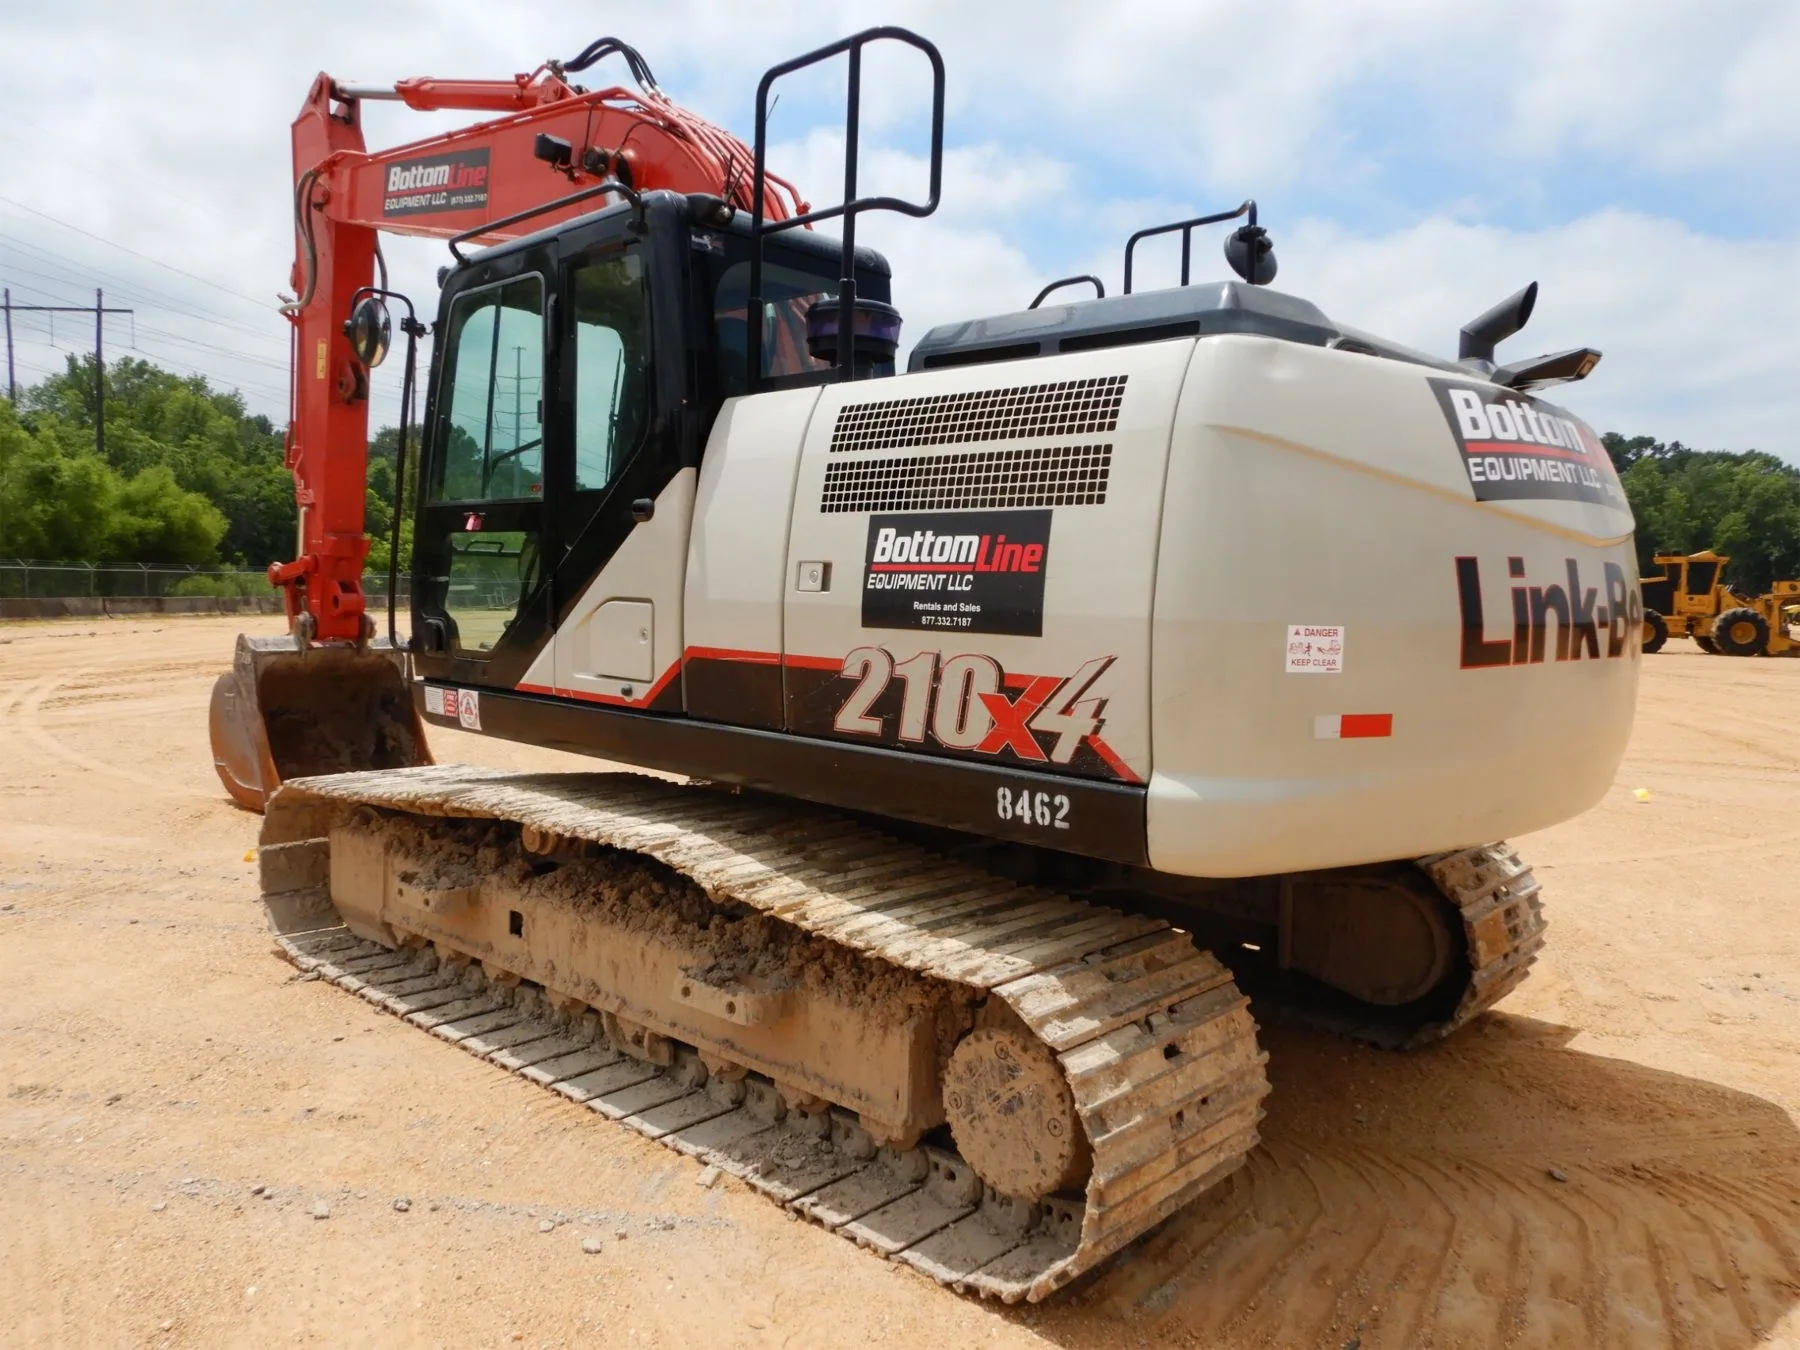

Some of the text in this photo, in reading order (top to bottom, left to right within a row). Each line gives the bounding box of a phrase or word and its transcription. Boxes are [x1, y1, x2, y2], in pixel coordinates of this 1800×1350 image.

[387, 163, 486, 192] BottomLine
[384, 194, 431, 210] EQUIPMENT
[431, 191, 447, 205] LLC
[1467, 457, 1601, 489] EQUIPMENT LLC
[873, 527, 1043, 572] BottomLine
[867, 573, 973, 591] EQUIPMENT LLC
[913, 601, 981, 613] Rentals and Sales
[921, 615, 971, 627] 877.332.7187
[1304, 628, 1338, 637] DANGER
[1313, 659, 1336, 667] CLEAR
[997, 786, 1070, 829] 8462
